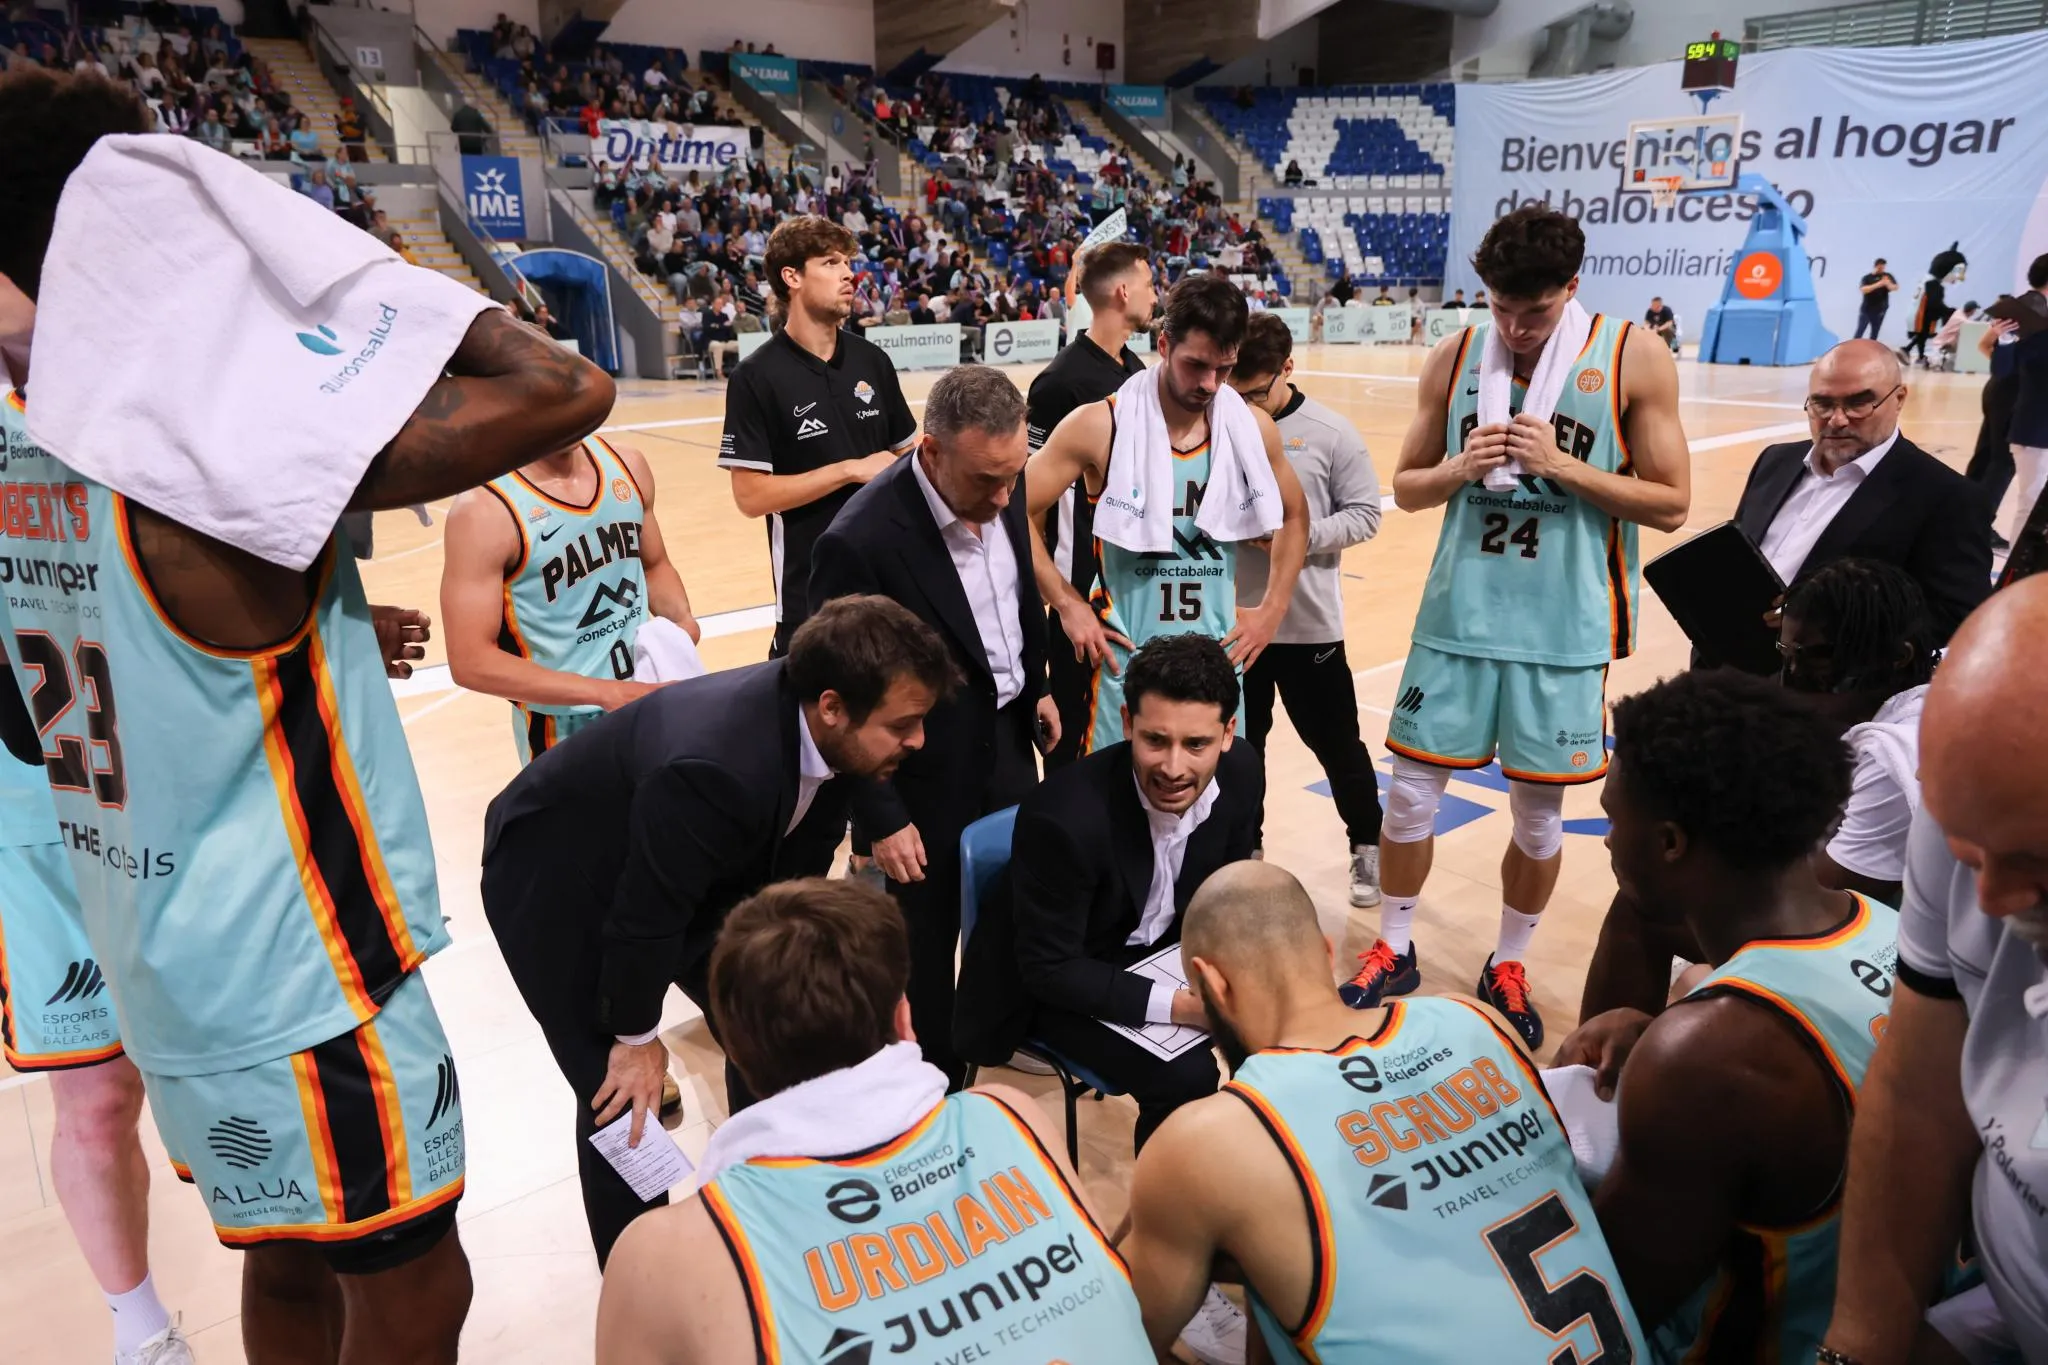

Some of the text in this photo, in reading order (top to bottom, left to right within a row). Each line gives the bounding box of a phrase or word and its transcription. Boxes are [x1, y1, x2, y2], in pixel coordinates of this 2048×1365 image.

[360, 50, 379, 64] 13
[606, 127, 737, 166] Ontime
[1774, 116, 1822, 160] al
[1832, 115, 2016, 168] hogar
[469, 194, 520, 217] IME
[1467, 494, 1567, 515] conectabalear
[1481, 512, 1540, 559] 24
[1135, 565, 1225, 577] conectabalear
[1159, 582, 1202, 622] 15
[609, 639, 635, 681] 0
[14, 628, 128, 812] 23
[42, 1007, 108, 1024] ESPORTS
[43, 1029, 111, 1045] BALEARS
[1384, 1047, 1453, 1084] Baleares
[1335, 1056, 1521, 1168] SCRUBB
[424, 1119, 463, 1154] ESPORT
[427, 1141, 459, 1168] ILLES
[1411, 1108, 1545, 1191] Juniper
[212, 1177, 308, 1206] ALUA
[890, 1147, 976, 1202] Baleares
[1433, 1184, 1499, 1219] TRAVEL
[804, 1166, 1053, 1312] URDIAIN
[884, 1233, 1084, 1354] Juniper
[1480, 1189, 1638, 1365] 5
[994, 1276, 1106, 1347] TECHNOLOGY
